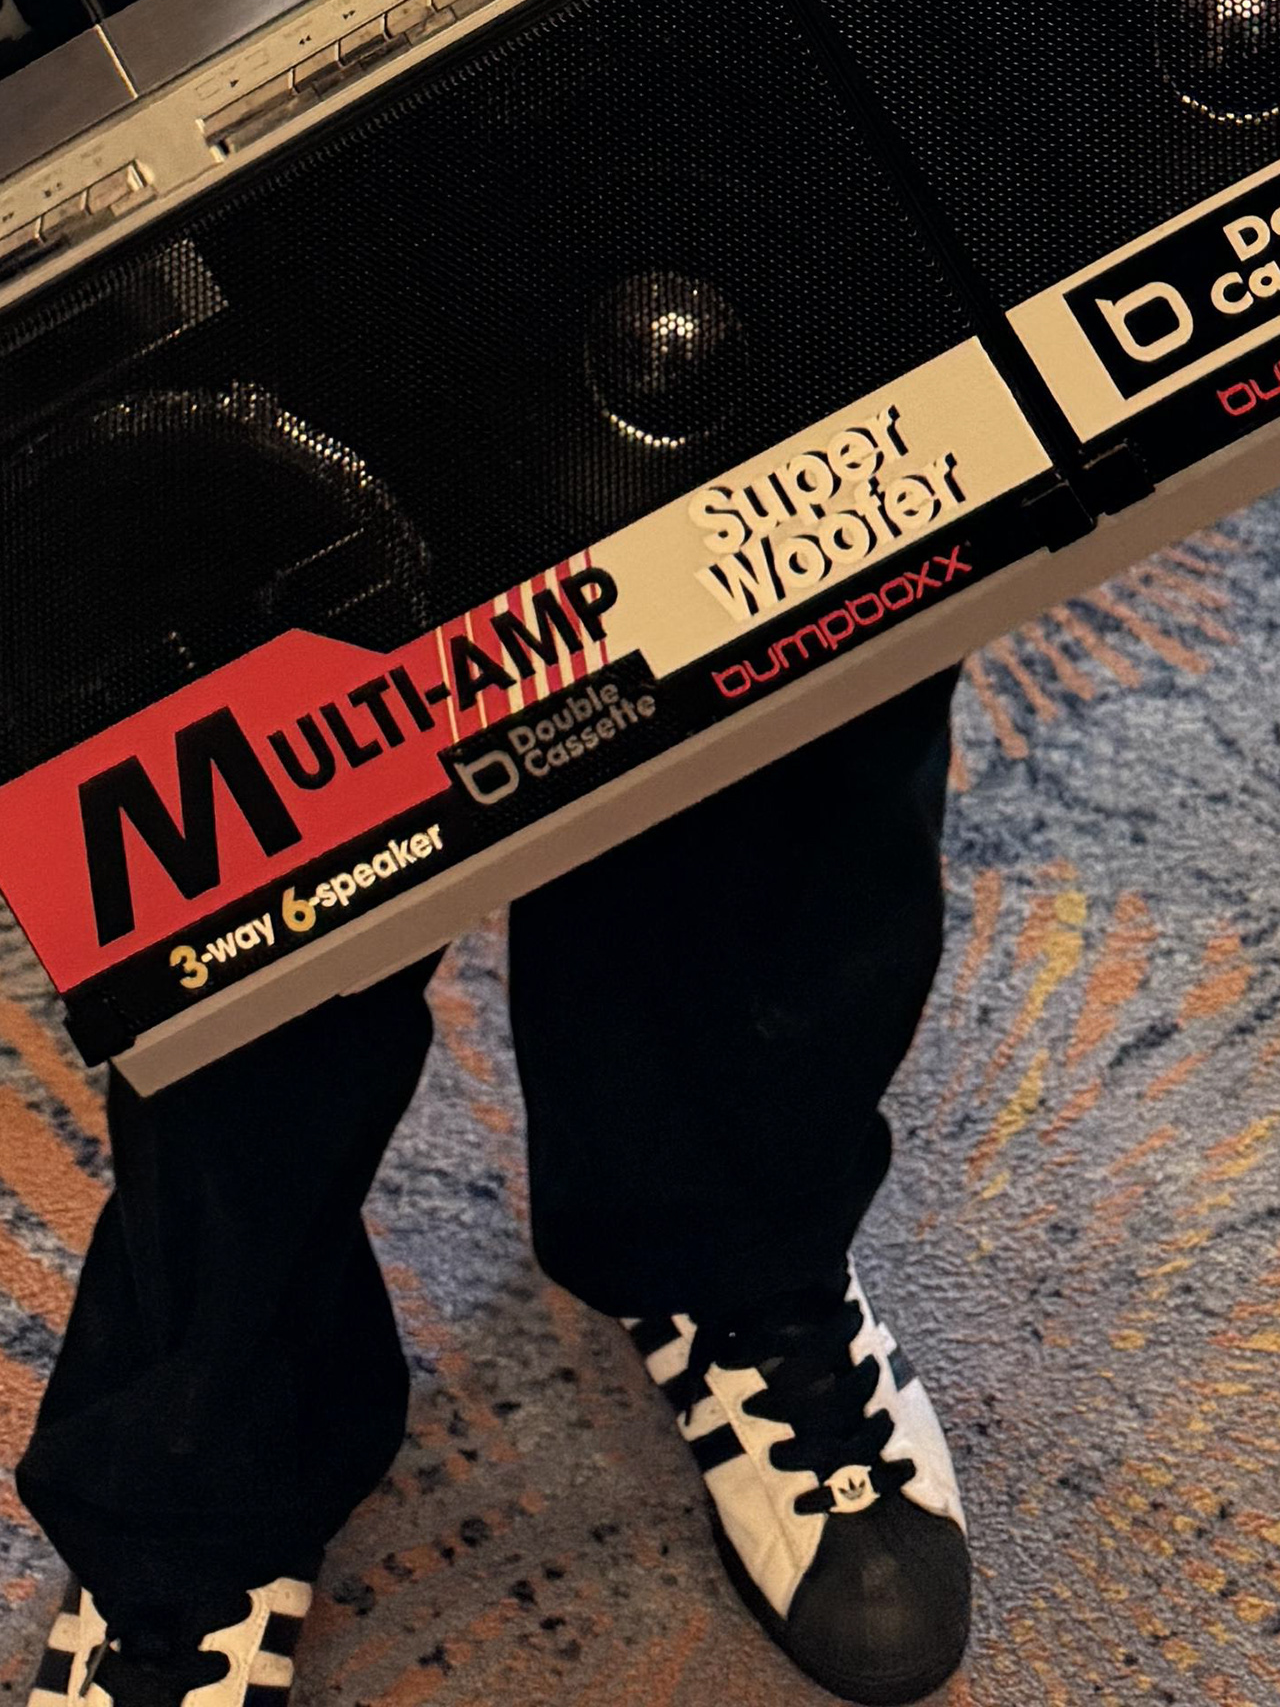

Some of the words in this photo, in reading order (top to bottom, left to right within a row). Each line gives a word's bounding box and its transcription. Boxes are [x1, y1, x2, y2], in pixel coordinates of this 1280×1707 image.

[692, 402, 908, 556] Super
[694, 452, 967, 621] Woofer
[711, 544, 973, 699] bumpboxx
[80, 567, 618, 947] MULTI-AMP
[508, 677, 623, 756] Double
[521, 688, 661, 780] Cassette
[169, 912, 275, 986] 3-way
[285, 821, 444, 932] 6-speaker
